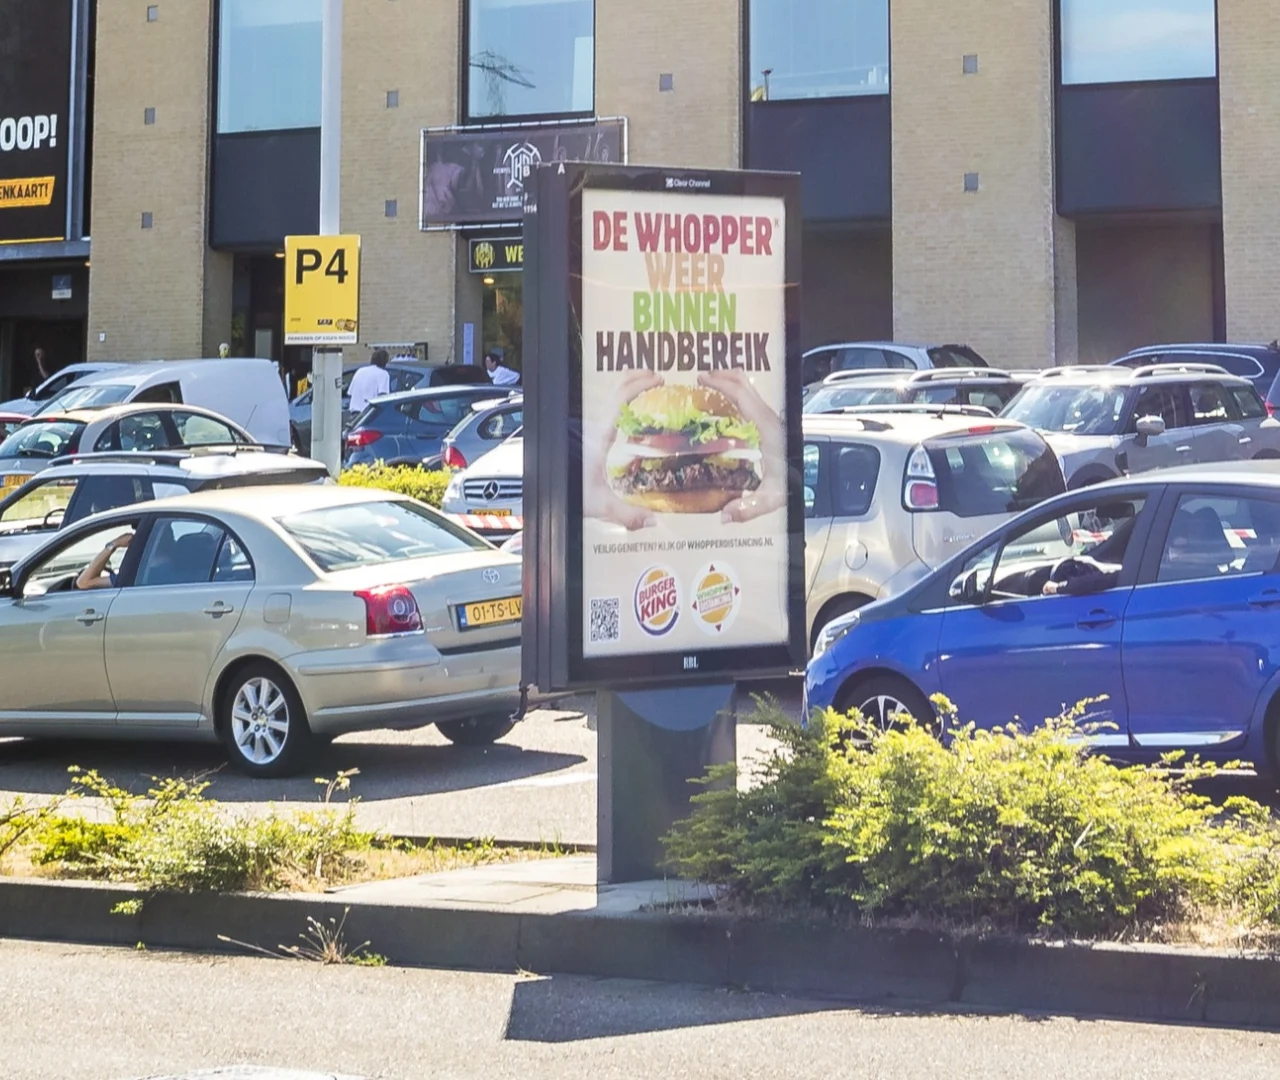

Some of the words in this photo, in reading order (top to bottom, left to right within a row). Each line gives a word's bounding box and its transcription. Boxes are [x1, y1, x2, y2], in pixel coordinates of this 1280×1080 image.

[592, 210, 628, 251] DE
[296, 248, 348, 285] P4
[645, 252, 725, 292] WEER
[633, 291, 736, 332] BINNEN
[596, 331, 771, 372] HANDBEREIK
[593, 543, 617, 554] VEILIG
[617, 541, 657, 553] GENIETEN?
[658, 540, 675, 551] KIJK
[675, 540, 686, 551] OP
[687, 537, 774, 550] WHOPPERDISTANCING.NL
[639, 577, 675, 605] BURGER
[641, 589, 676, 623] KING
